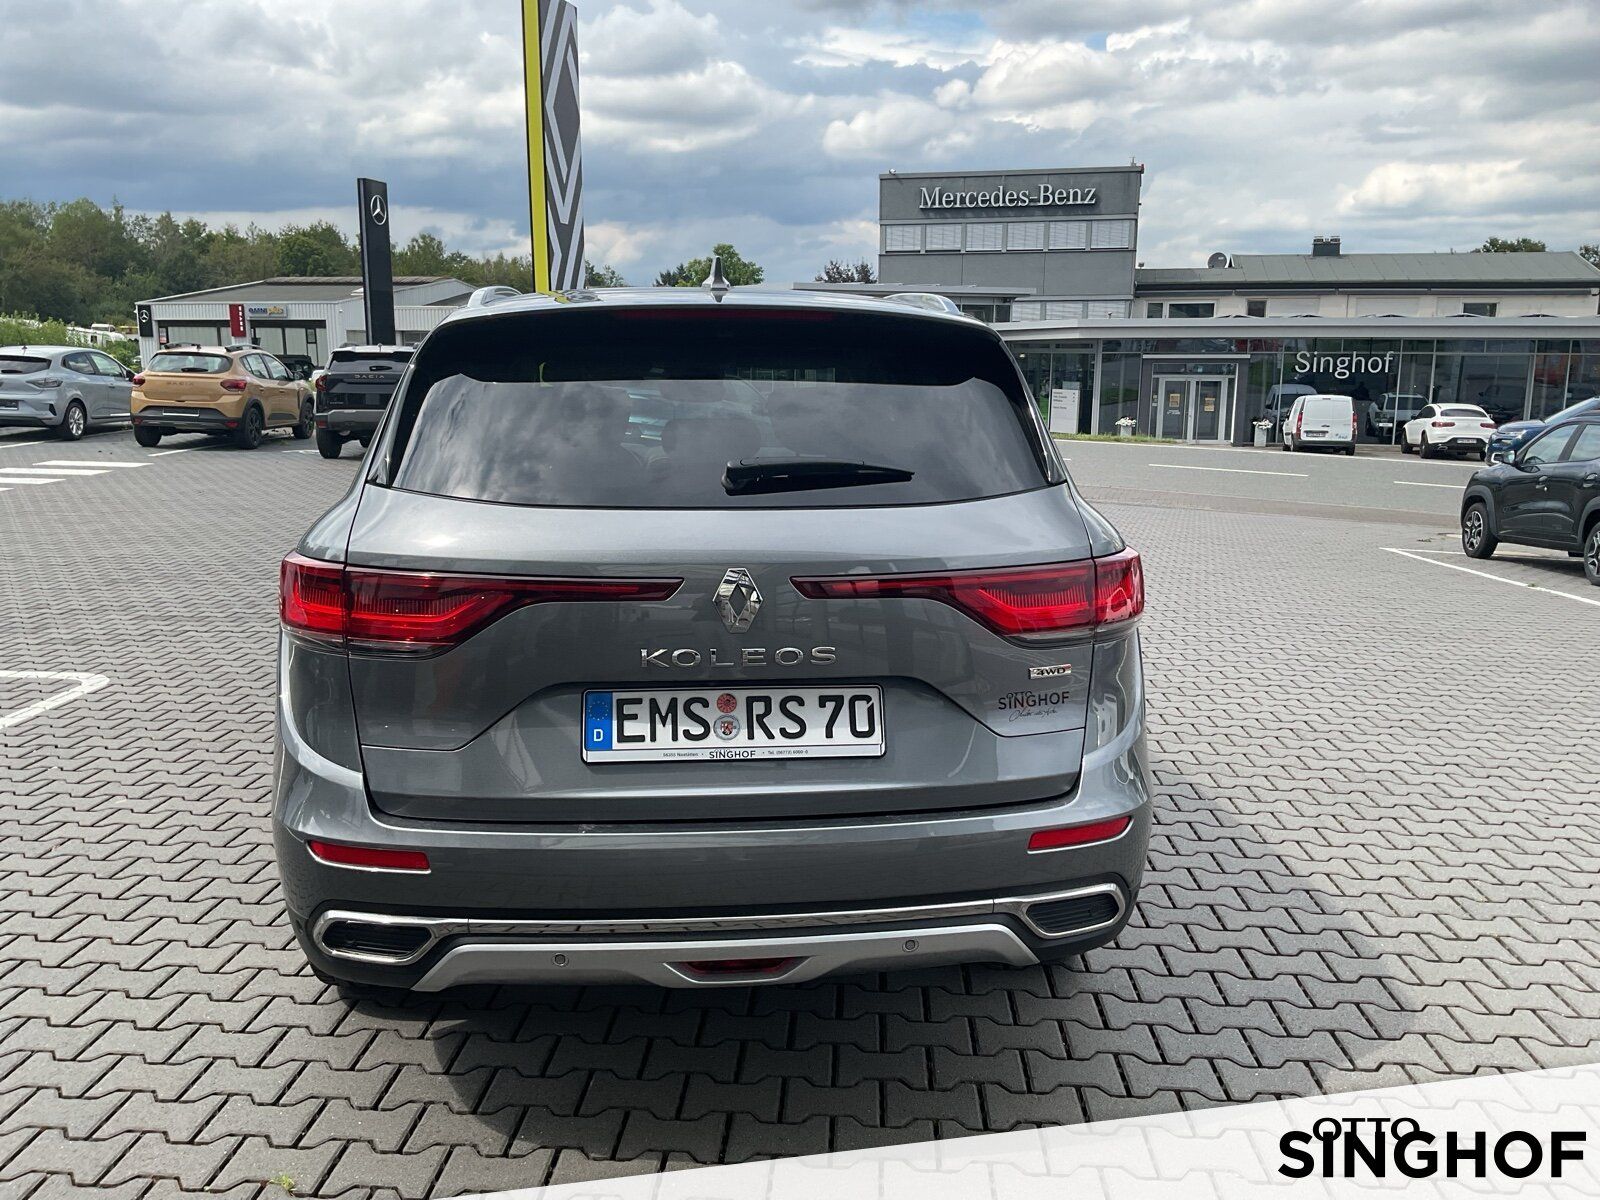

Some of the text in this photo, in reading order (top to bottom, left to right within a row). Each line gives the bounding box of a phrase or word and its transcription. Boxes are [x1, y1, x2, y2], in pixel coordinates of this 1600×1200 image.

[919, 183, 1097, 209] Mercedes-Benz
[1294, 351, 1395, 378] Singhof
[640, 646, 837, 668] KOLEOS
[1033, 666, 1067, 677] 4WD
[998, 691, 1070, 710] SINGHOF
[616, 694, 876, 743] EMS RS 70
[593, 728, 604, 742] D
[709, 750, 756, 759] SINGHOF
